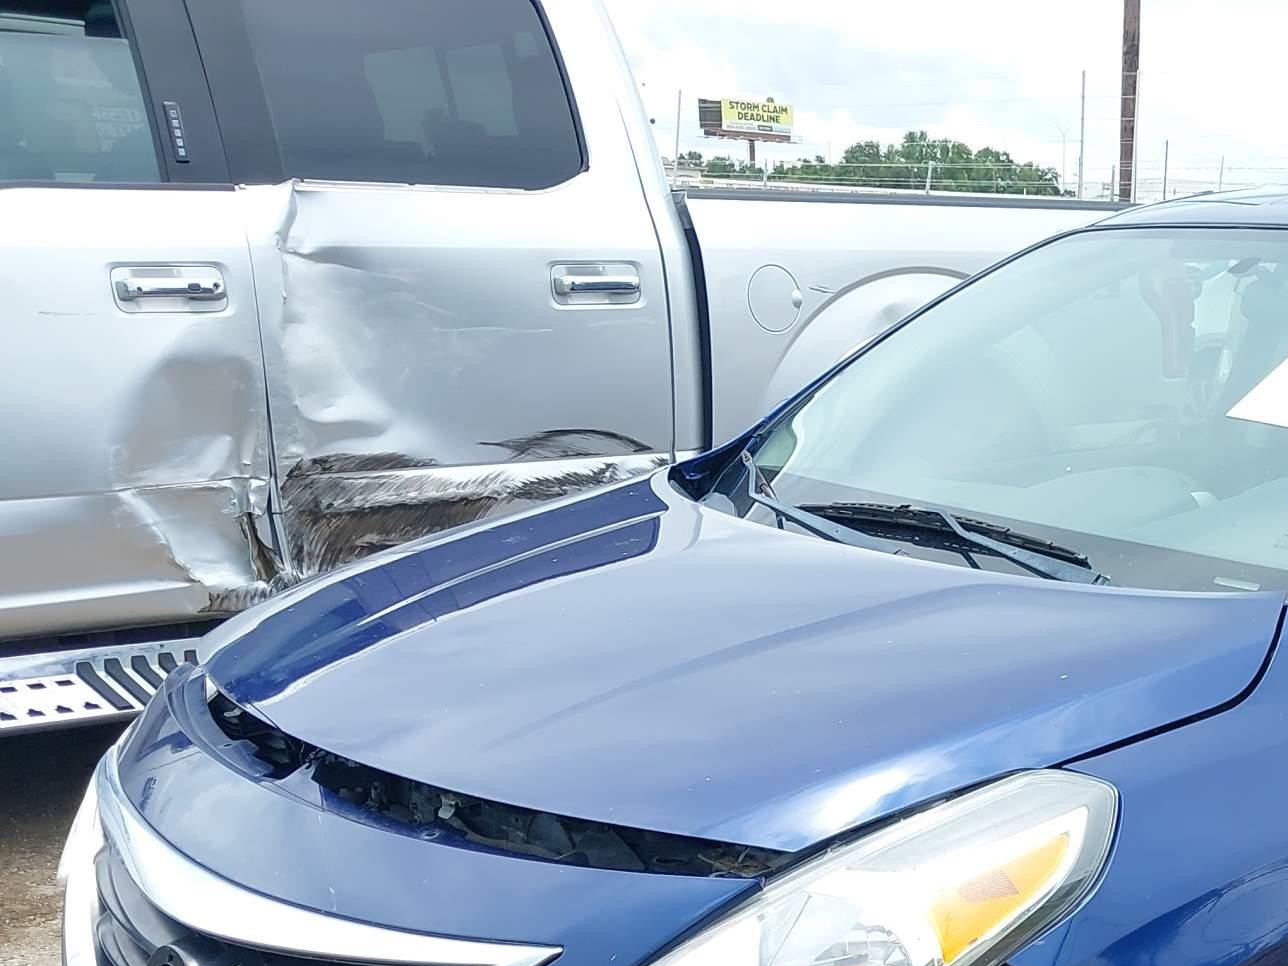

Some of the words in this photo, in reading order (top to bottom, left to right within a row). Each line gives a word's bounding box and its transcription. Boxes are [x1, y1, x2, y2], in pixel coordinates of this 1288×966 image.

[729, 101, 760, 112] STORM
[761, 104, 788, 115] CLAIM
[737, 111, 781, 123] DEADLINE
